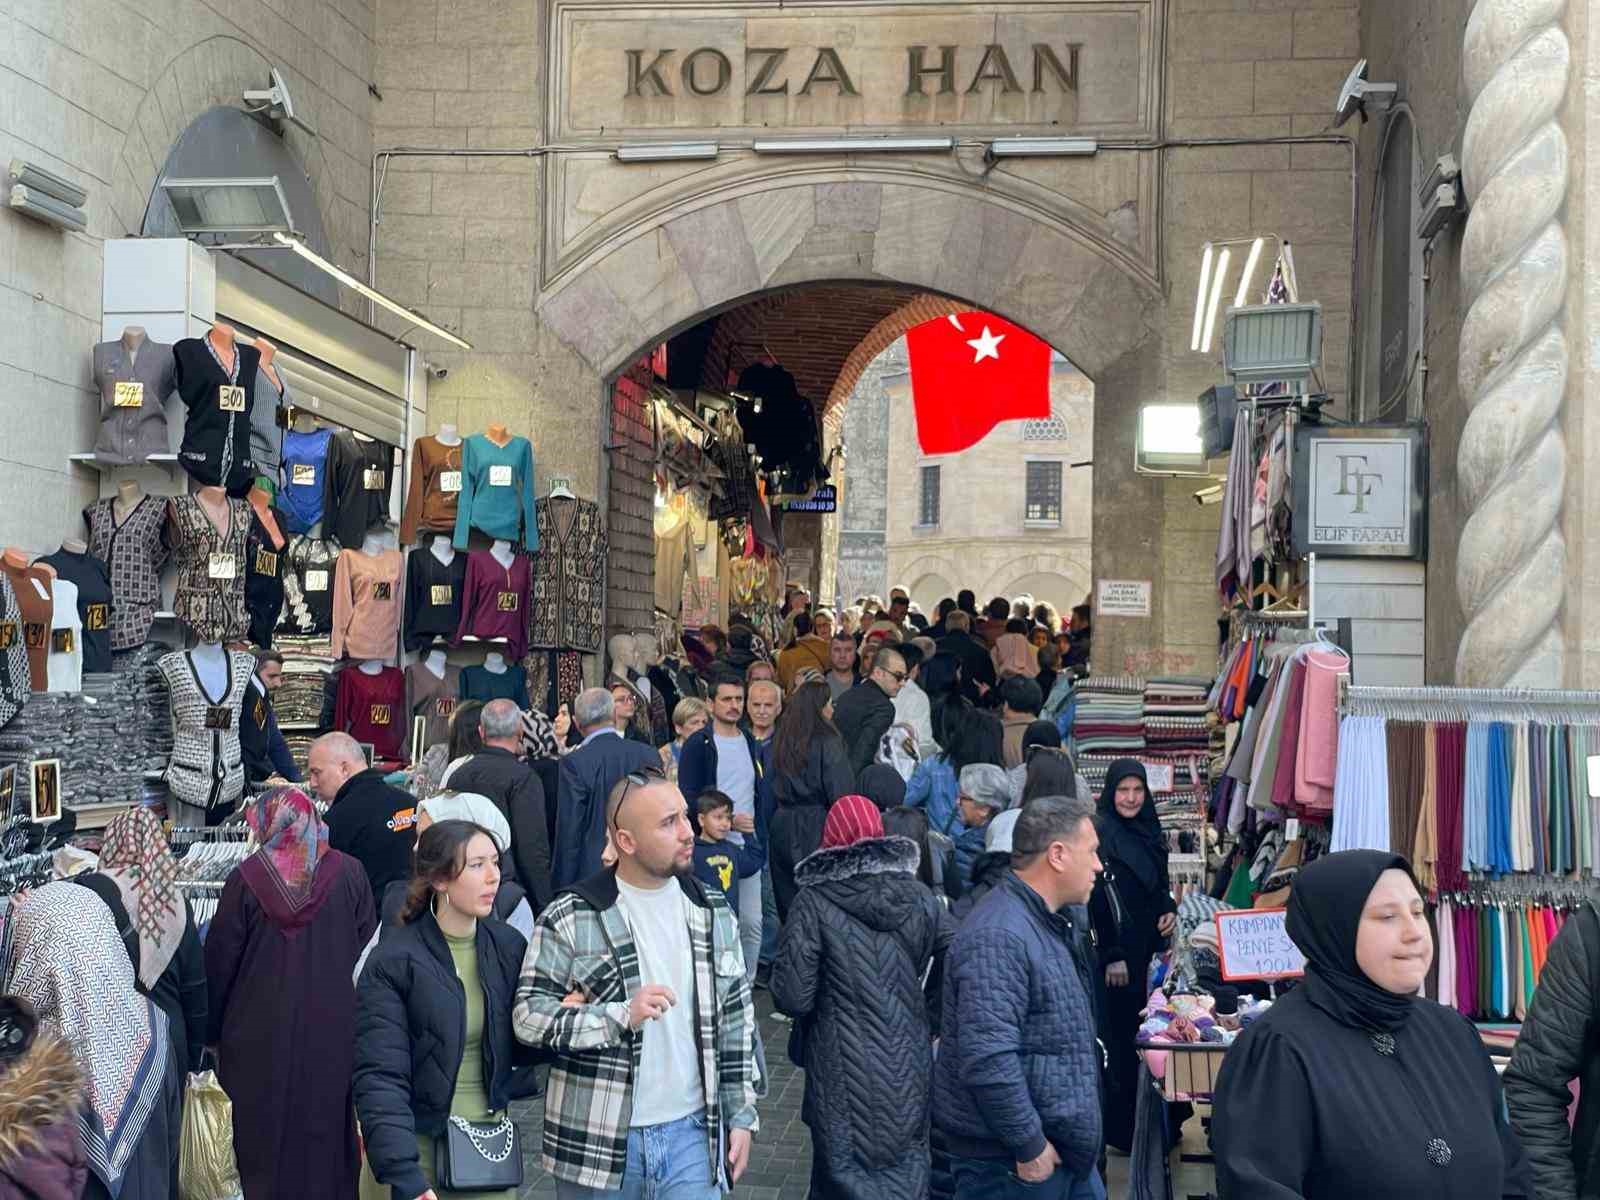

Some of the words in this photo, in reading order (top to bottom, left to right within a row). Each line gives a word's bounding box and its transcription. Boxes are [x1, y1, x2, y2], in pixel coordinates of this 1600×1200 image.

[624, 48, 862, 97] KOZA
[905, 43, 1084, 97] HAN
[221, 388, 243, 408] 300
[1314, 529, 1346, 541] ELIF
